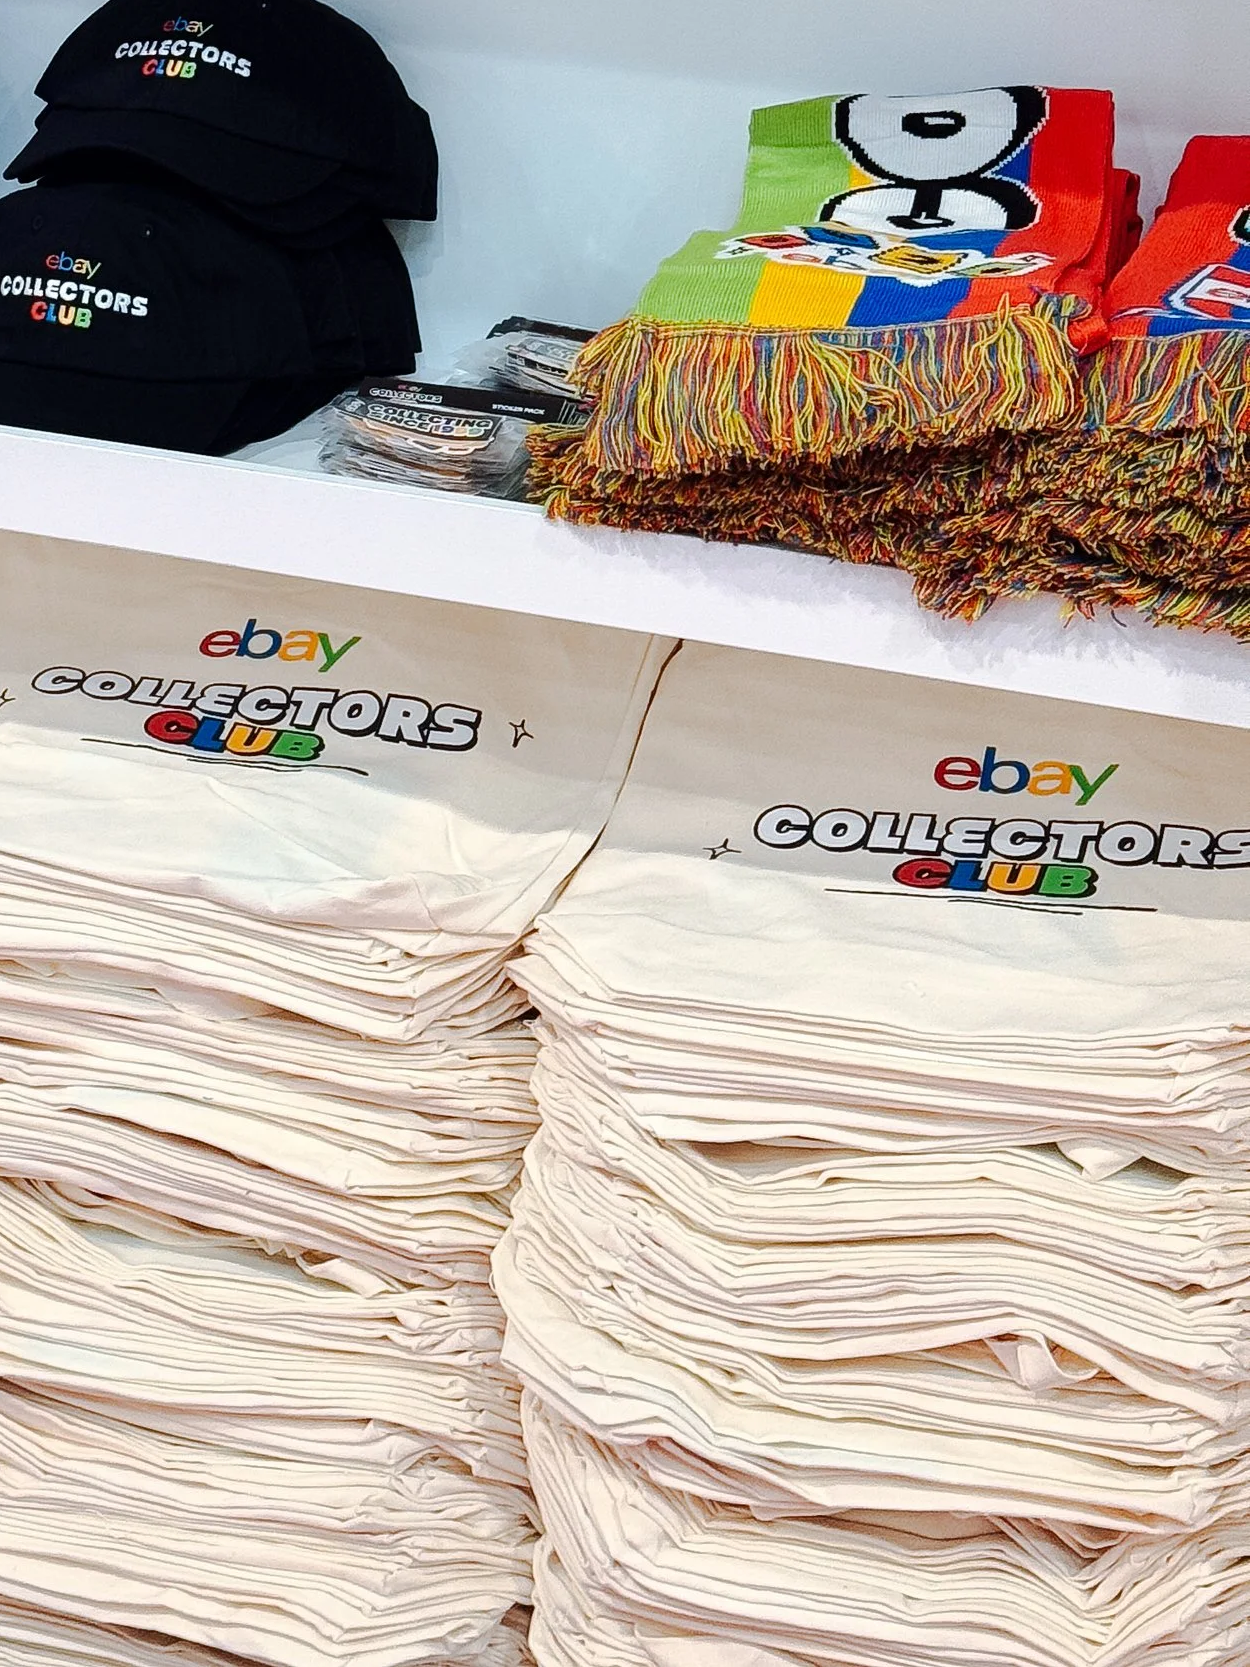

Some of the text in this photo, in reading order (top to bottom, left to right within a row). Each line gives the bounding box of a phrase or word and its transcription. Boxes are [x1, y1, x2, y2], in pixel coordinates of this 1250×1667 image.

[163, 16, 214, 37] ebay
[115, 39, 251, 77] COLLECTORS
[141, 58, 197, 79] CLUB
[45, 251, 102, 280] ebay
[0, 275, 148, 317] COLLECTORS
[30, 301, 92, 328] CLUB
[366, 410, 431, 433] SINCE
[367, 403, 493, 429] COLLECTING
[524, 407, 546, 415] PACK
[198, 619, 361, 672] ebay
[31, 665, 484, 752] COLLECTORS
[144, 710, 325, 761] CLUB
[933, 746, 1119, 806] ebay
[892, 857, 1100, 898] CLUB
